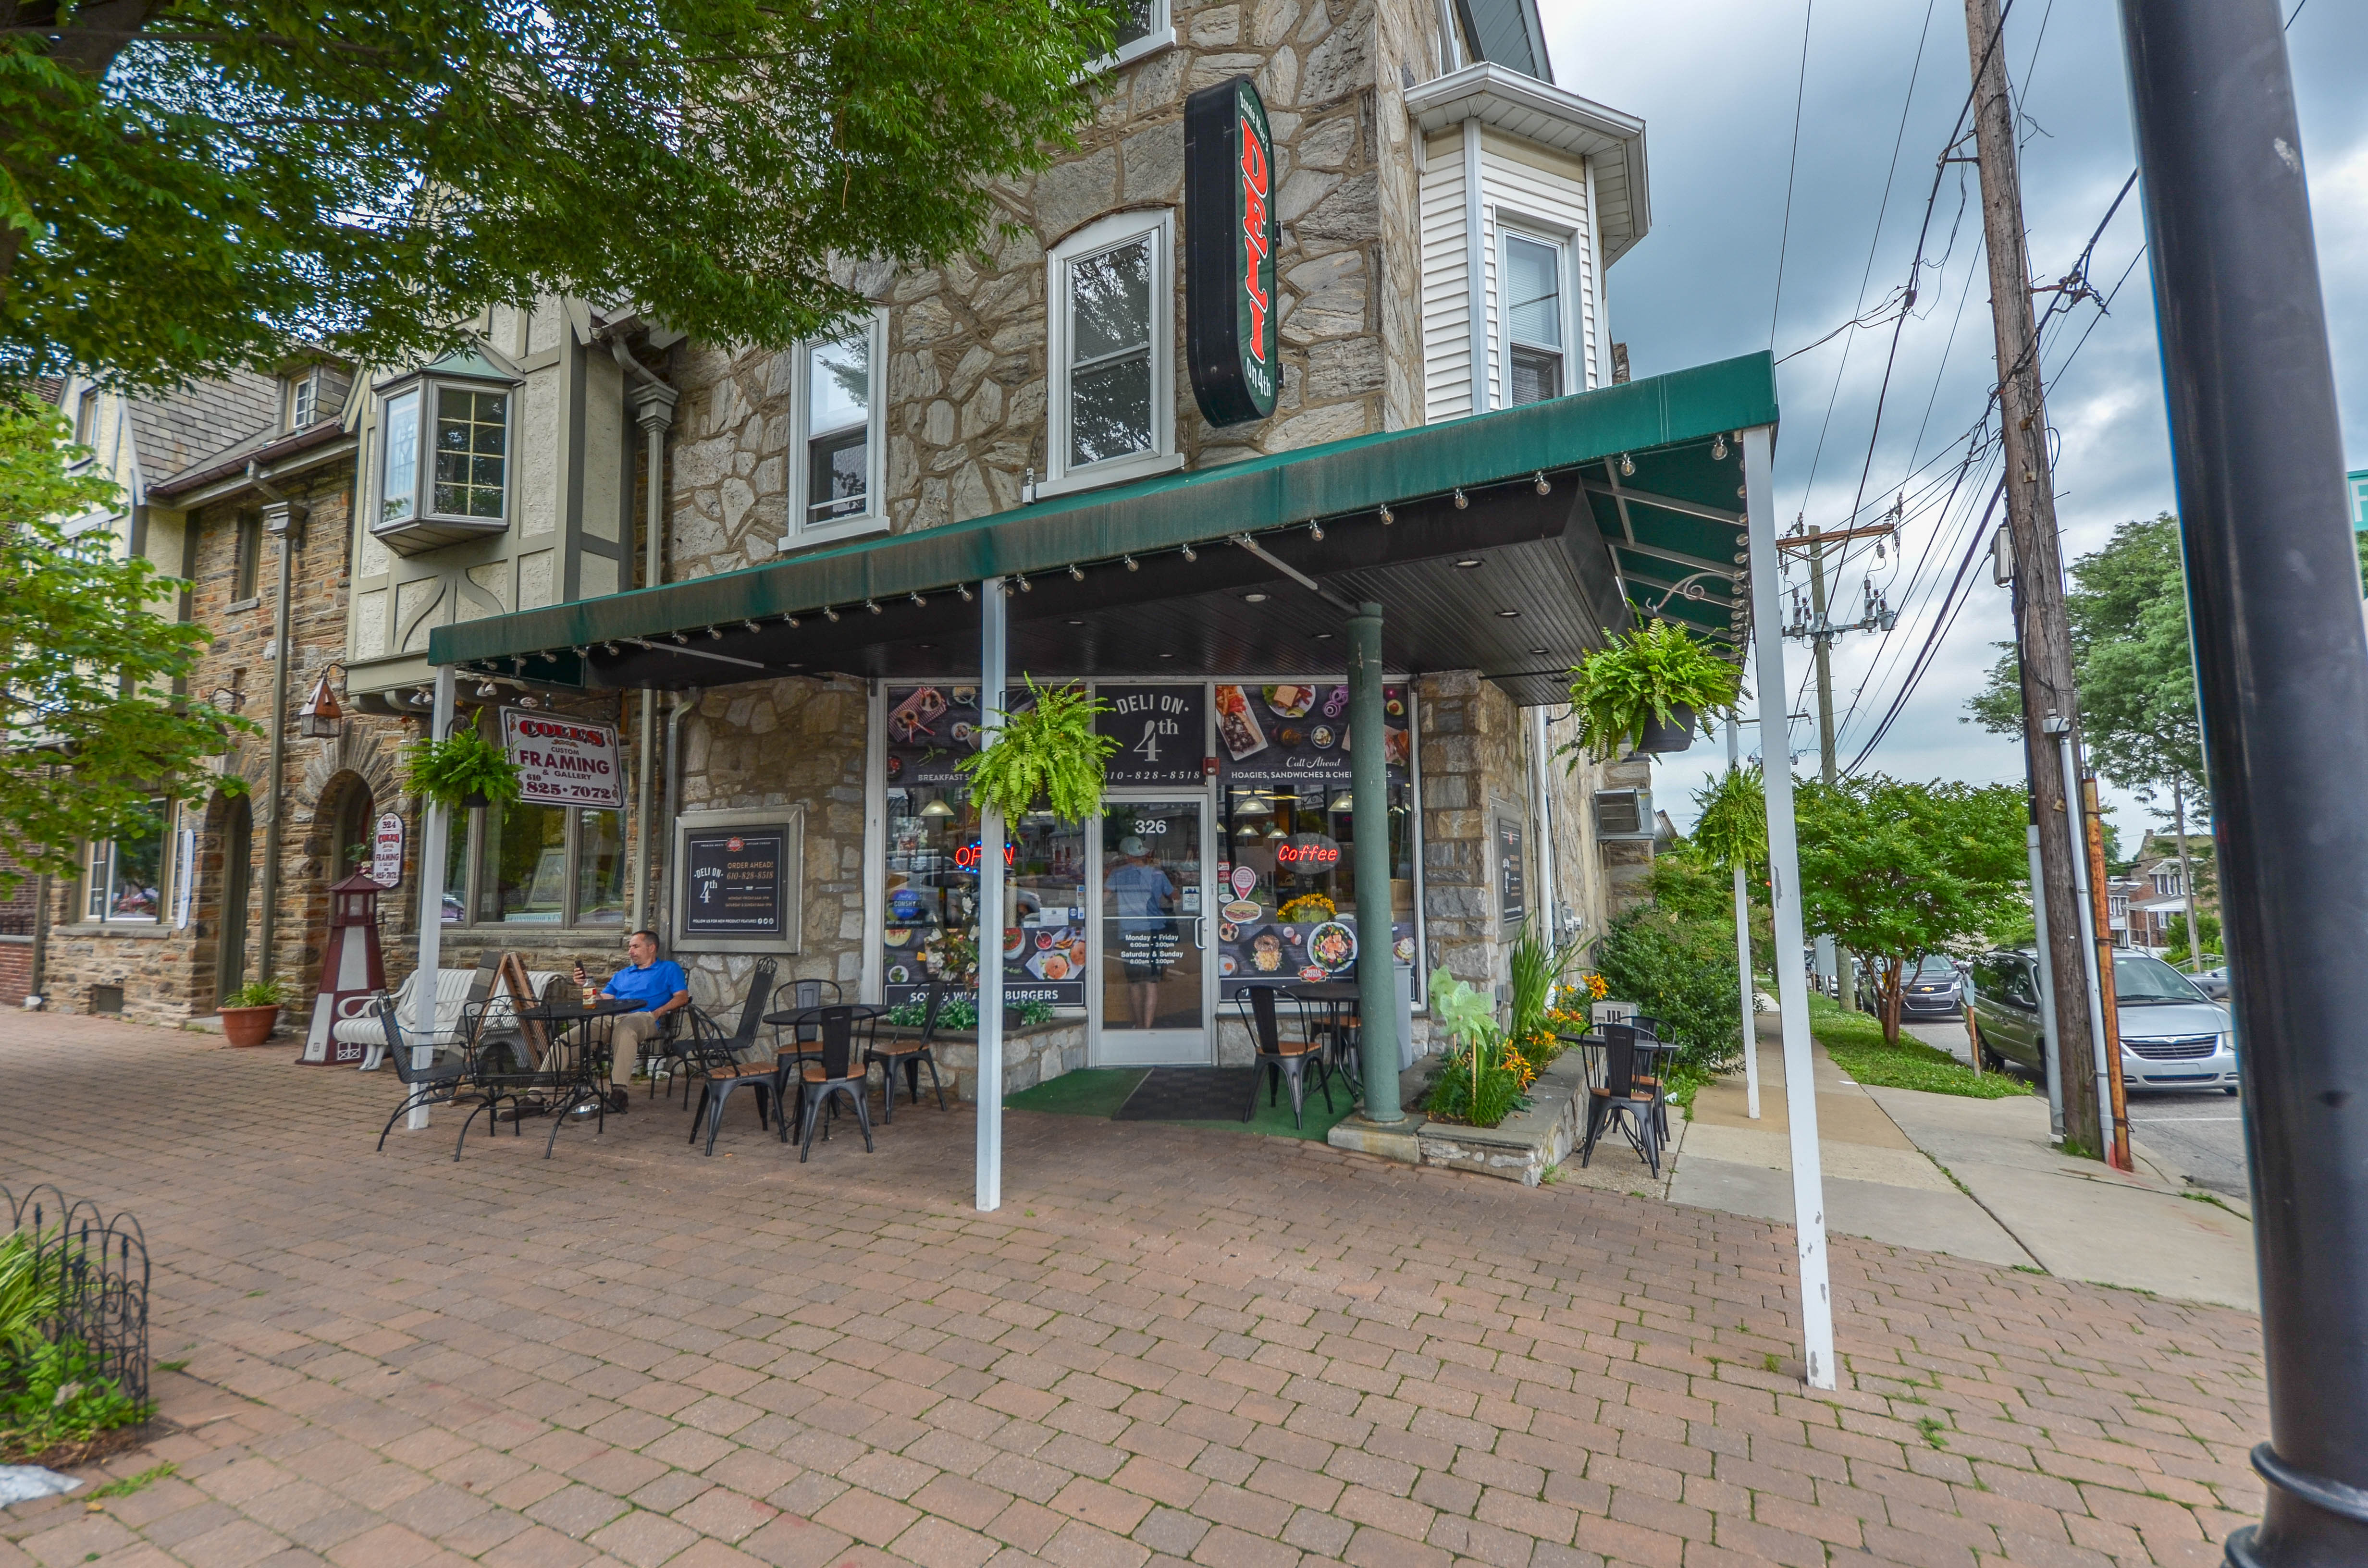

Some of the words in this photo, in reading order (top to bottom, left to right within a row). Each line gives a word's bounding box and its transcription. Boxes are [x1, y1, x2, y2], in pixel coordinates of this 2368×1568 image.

[1239, 91, 1256, 124] Donnie
[1256, 115, 1269, 152] Mac's
[1240, 115, 1269, 364] DELI
[1116, 694, 1153, 715] DELI
[1161, 695, 1184, 715] ON
[1133, 718, 1179, 761] 4th
[551, 747, 580, 756] CUSTOM
[519, 749, 610, 774] FRAMING
[1286, 756, 1305, 768] Call
[1307, 757, 1342, 768] Ahead
[526, 773, 541, 782] 610
[554, 770, 592, 781] GALLERY
[382, 821, 396, 829] 324
[1135, 820, 1167, 834] 326
[375, 853, 399, 861] FRAMING
[955, 846, 1014, 866] OPN
[1278, 844, 1338, 861] Coffee
[696, 867, 710, 879] DELI
[712, 868, 722, 878] ON
[727, 871, 774, 880] 610-828-8518
[700, 880, 718, 903] 4th
[1005, 990, 1059, 1000] BURGERS
